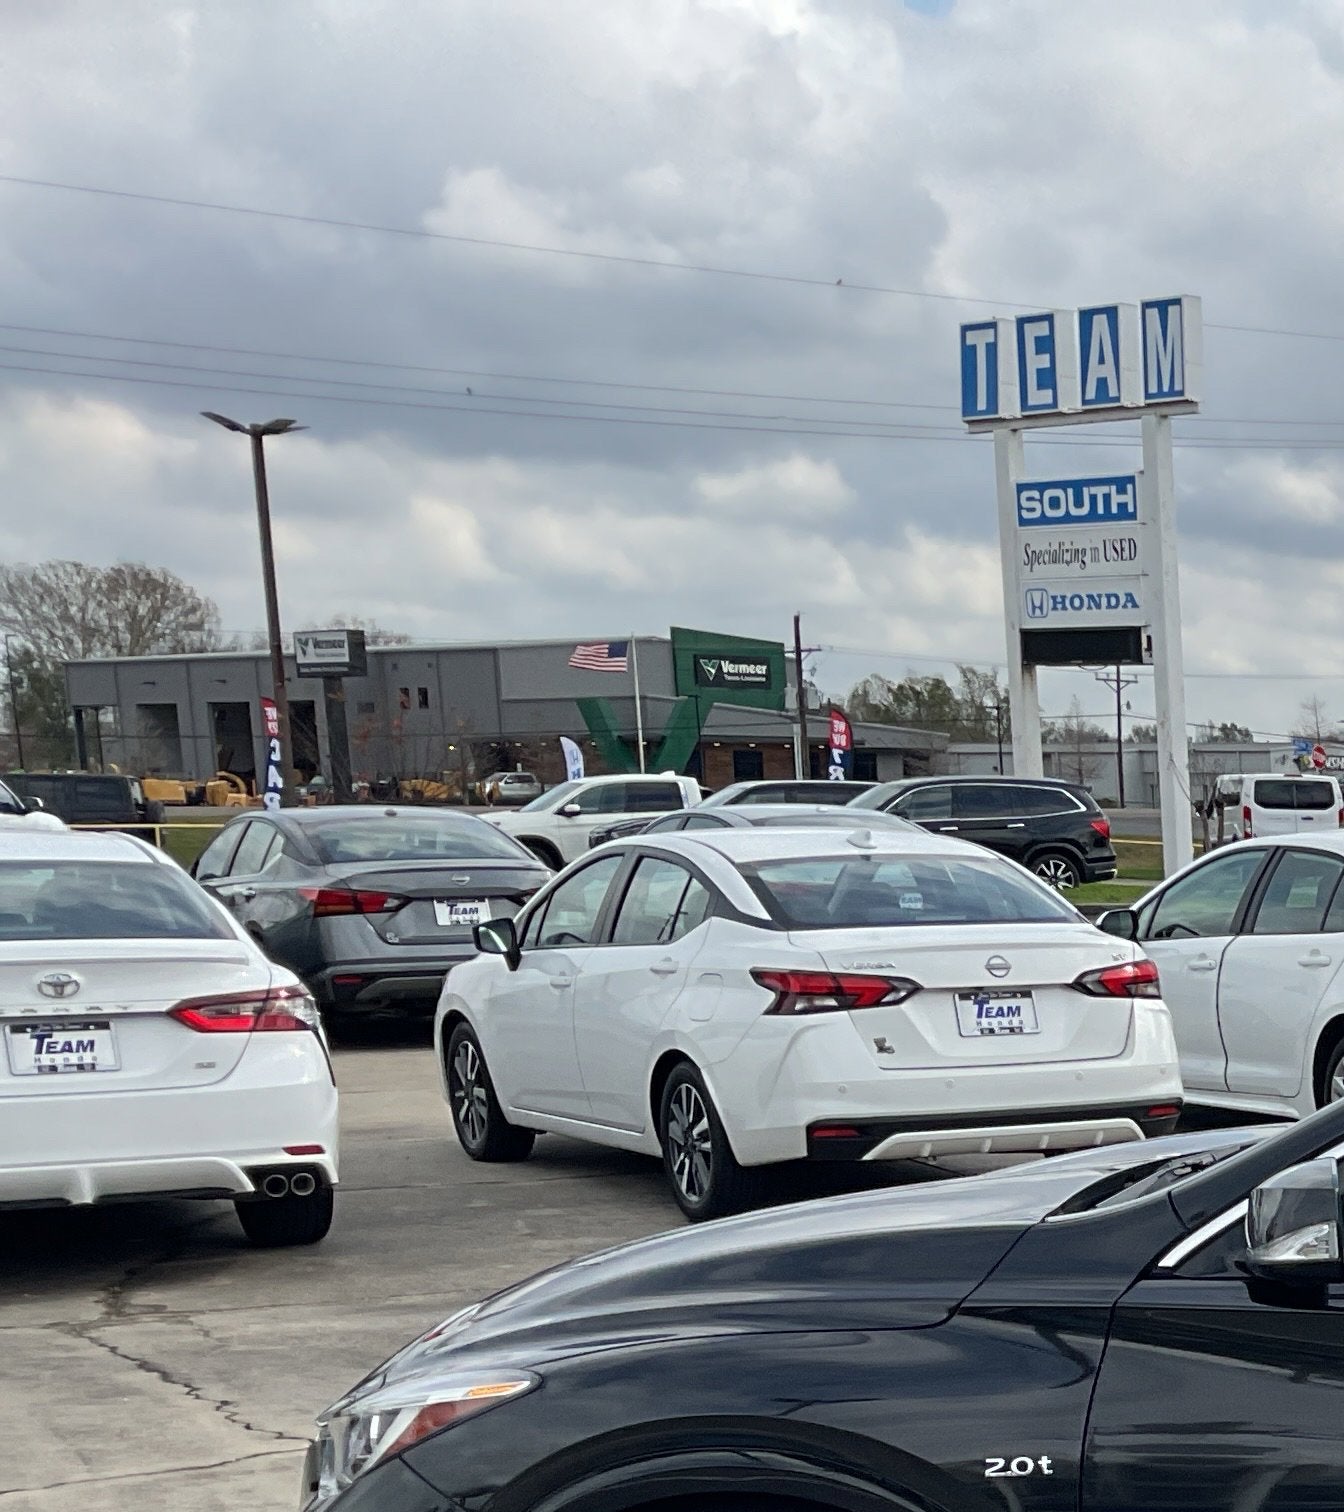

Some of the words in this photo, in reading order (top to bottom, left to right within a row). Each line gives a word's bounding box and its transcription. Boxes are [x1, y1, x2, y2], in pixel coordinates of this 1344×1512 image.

[966, 304, 1183, 412] TEAM
[1020, 484, 1134, 519] SOUTH
[1023, 541, 1087, 572] Specializing
[1090, 540, 1100, 564] in
[1103, 538, 1137, 562] USED
[1050, 592, 1140, 611] HONDA
[720, 660, 767, 675] Vermeer
